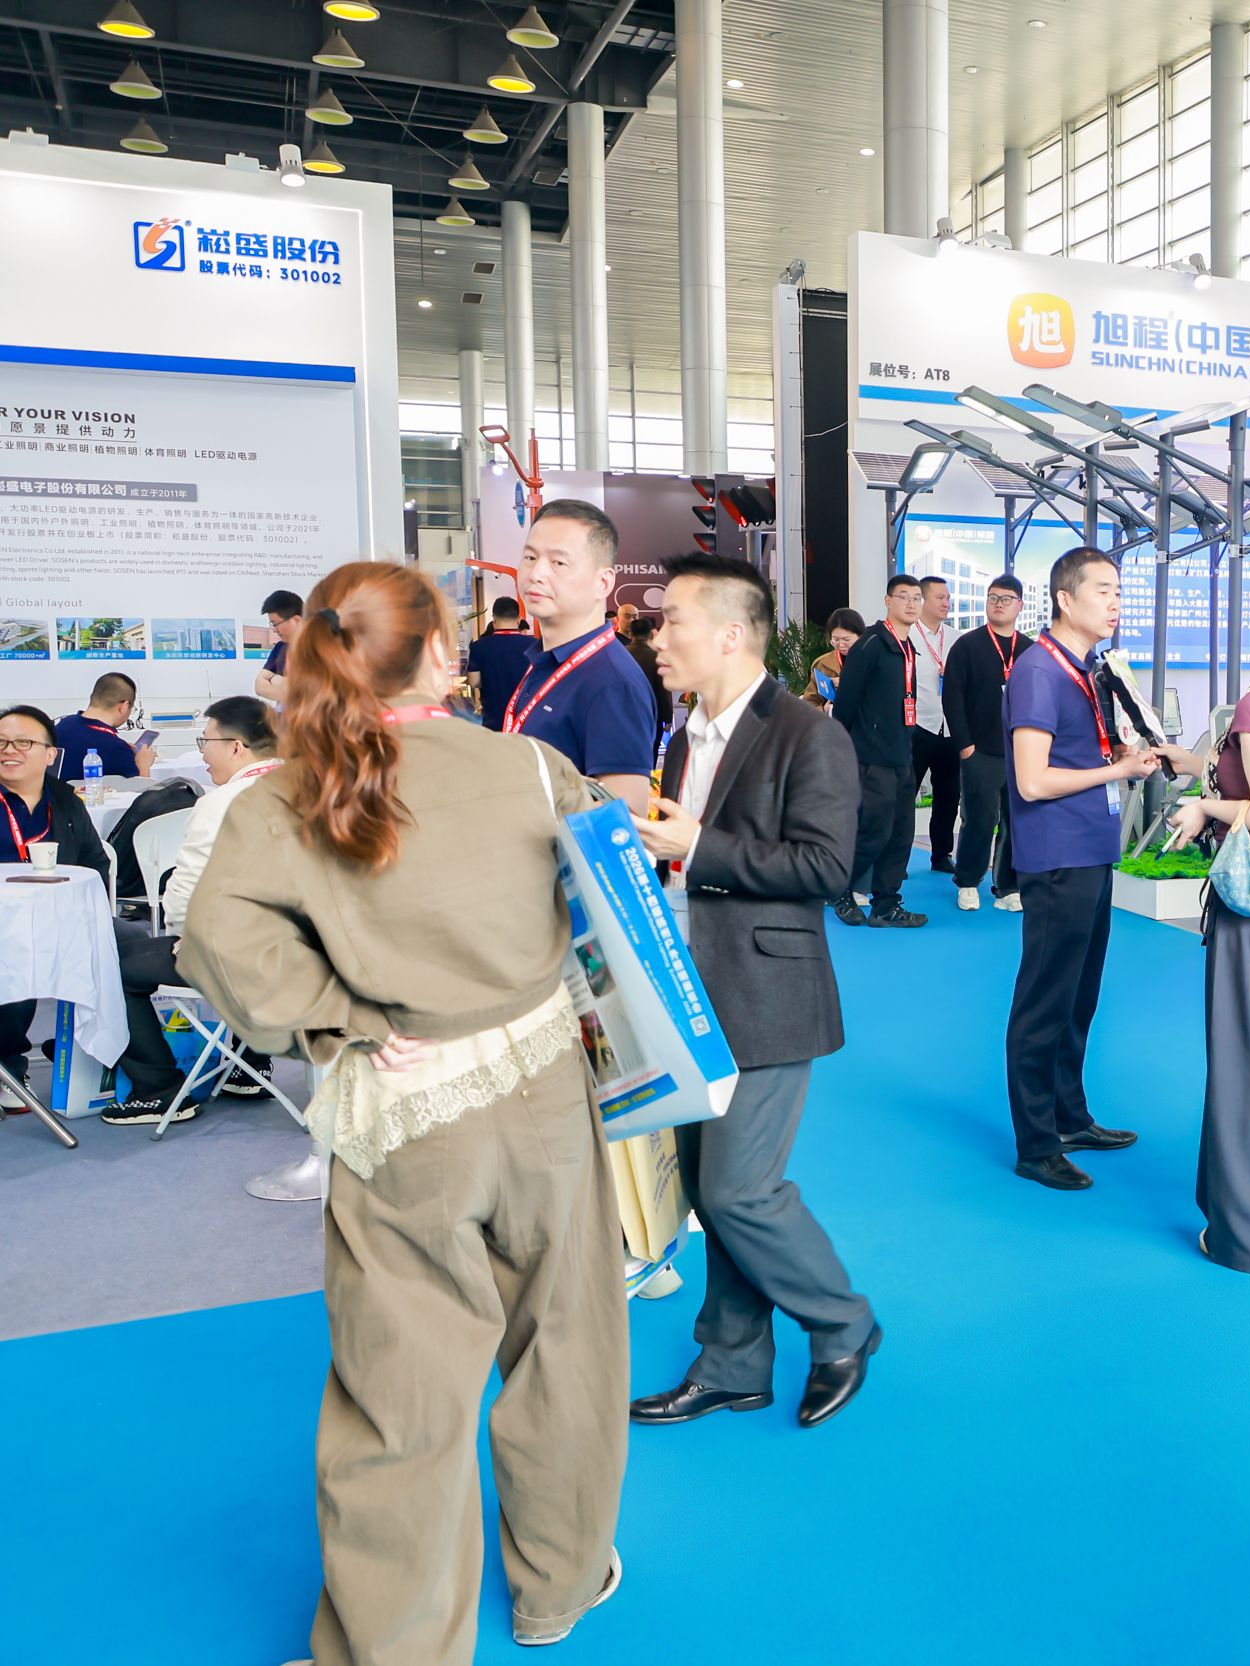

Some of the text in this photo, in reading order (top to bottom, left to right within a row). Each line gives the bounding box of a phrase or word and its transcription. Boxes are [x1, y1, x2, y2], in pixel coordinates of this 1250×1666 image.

[197, 228, 340, 265] 崧盛股份
[1018, 305, 1066, 354] 旭
[14, 408, 66, 420] YOUR
[72, 411, 135, 424] VISION
[130, 488, 187, 498] 成立于2011年
[6, 598, 43, 607] Global
[48, 599, 82, 608] layout
